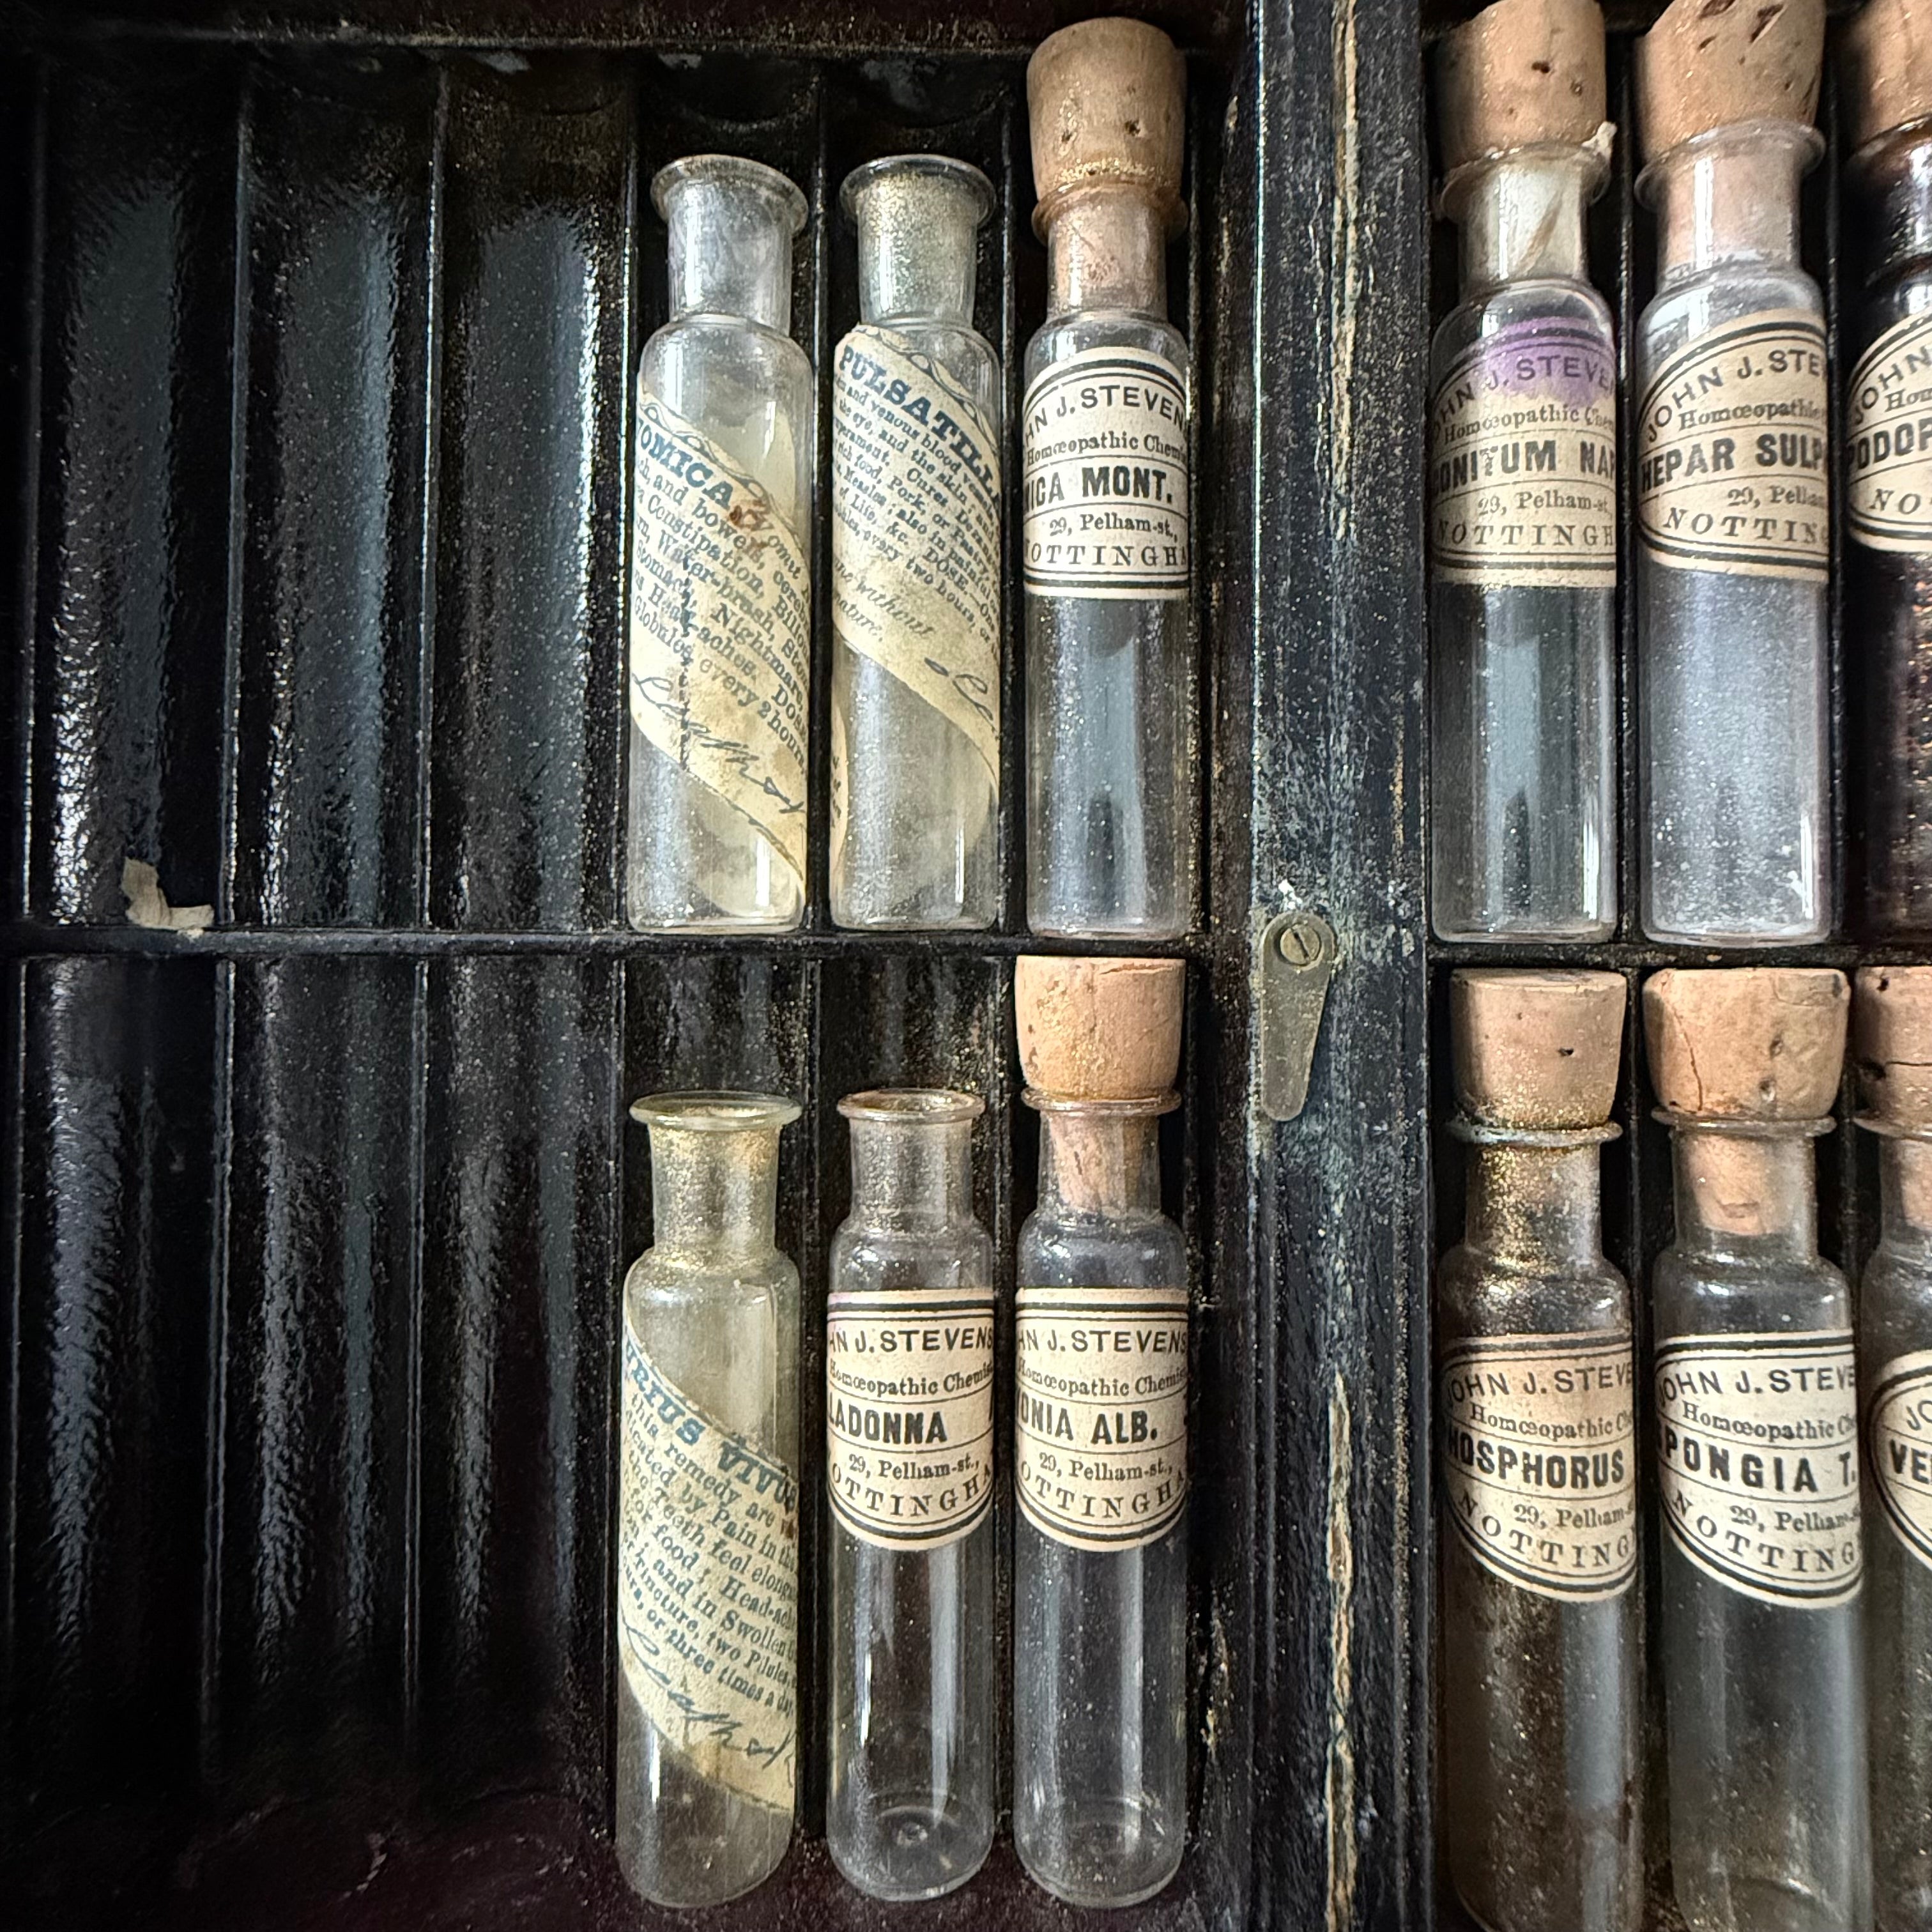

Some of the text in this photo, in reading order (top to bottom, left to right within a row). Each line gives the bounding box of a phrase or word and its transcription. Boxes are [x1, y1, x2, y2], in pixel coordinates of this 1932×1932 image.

[1648, 365, 1724, 443] JOHN
[878, 424, 908, 452] and
[911, 447, 935, 471] the
[920, 434, 961, 474] blood
[1641, 437, 1736, 494] HEPAR
[653, 468, 688, 506] and
[854, 452, 882, 482] food,
[887, 475, 926, 512] Pork,
[931, 512, 949, 530] or
[907, 467, 948, 506] Cures
[1081, 465, 1173, 504] MONT.
[895, 503, 928, 533] also
[1049, 517, 1073, 537] 29,
[648, 494, 765, 596] Constipation,
[905, 554, 934, 583] two
[699, 659, 759, 713] every
[756, 699, 771, 719] 2
[1091, 1409, 1159, 1446] ALB.
[631, 1392, 659, 1436] this
[664, 1445, 742, 1510] remedy
[745, 1501, 776, 1529] are
[848, 1453, 871, 1479] 29,
[1038, 1452, 1062, 1478] 29,
[652, 1489, 706, 1543] Teeth
[706, 1536, 753, 1575] feel
[707, 1505, 757, 1547] Pain
[1513, 1503, 1547, 1529] 29,
[1729, 1505, 1765, 1533] 29,
[653, 1556, 693, 1598] and
[719, 1607, 786, 1659] Swollen
[647, 1608, 666, 1632] or
[666, 1628, 715, 1673] three
[716, 1663, 763, 1702] times
[705, 1631, 741, 1662] two
